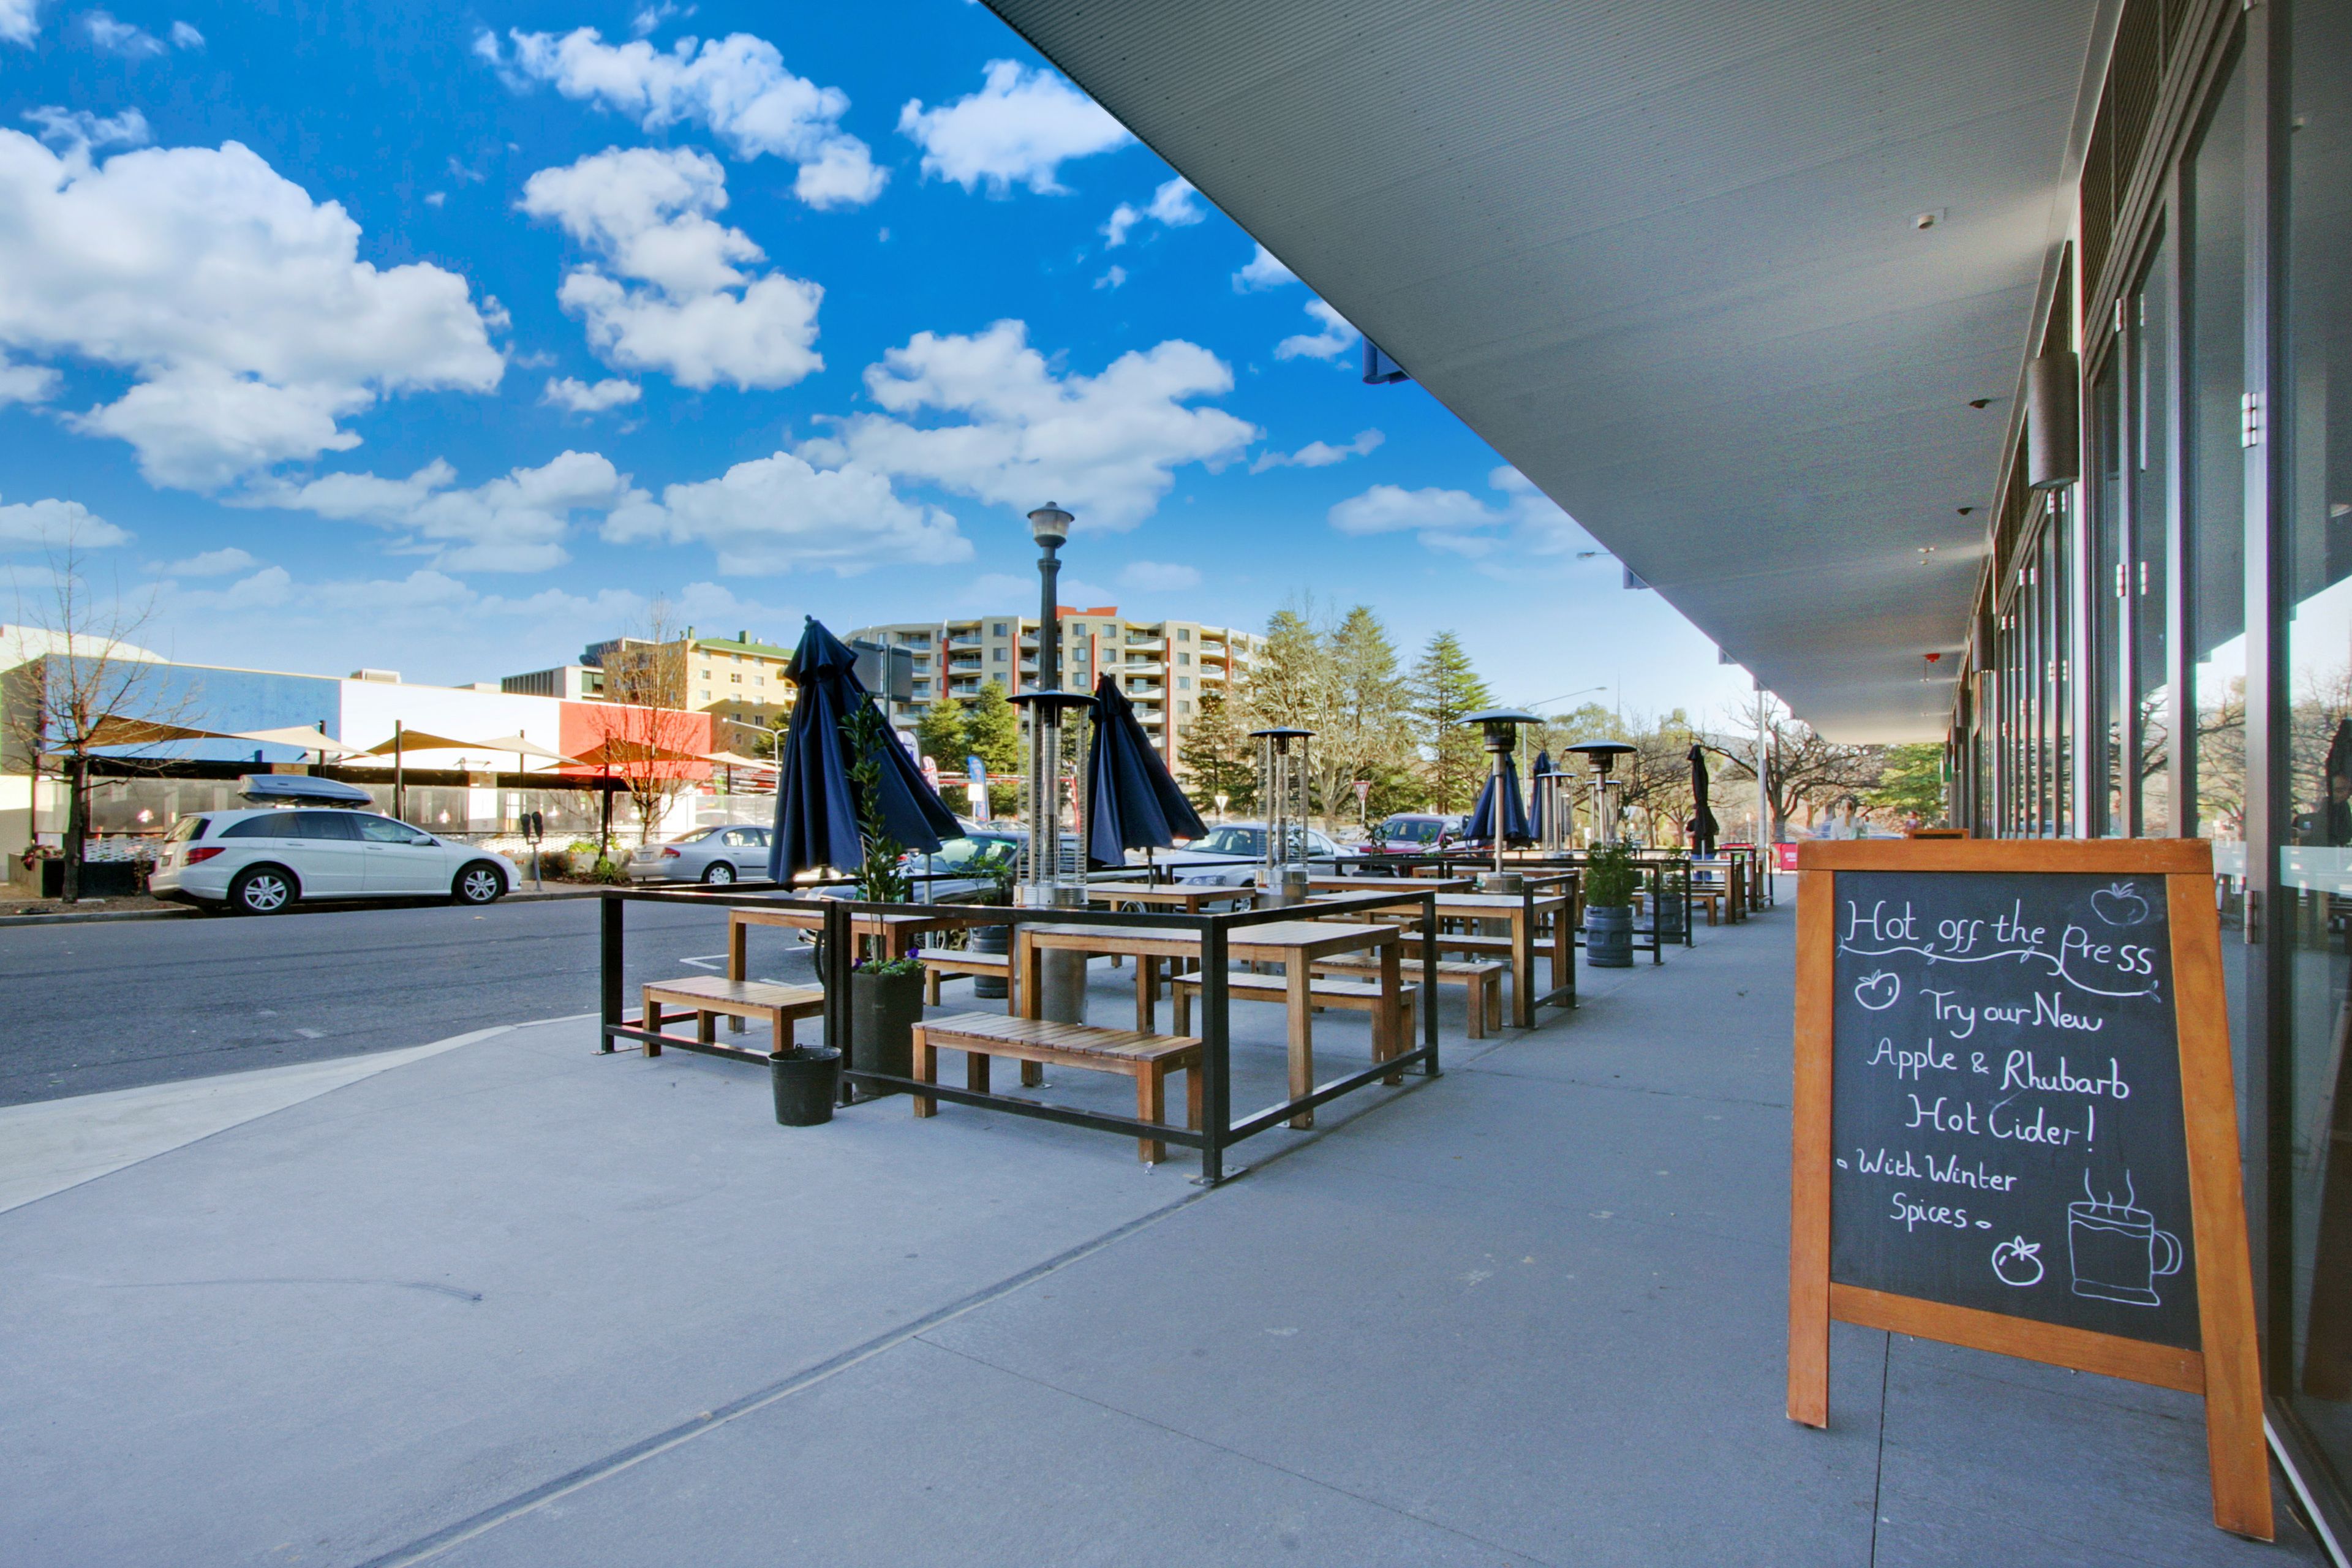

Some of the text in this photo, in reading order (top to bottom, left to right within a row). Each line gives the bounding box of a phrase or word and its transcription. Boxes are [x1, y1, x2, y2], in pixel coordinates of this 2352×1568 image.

[1845, 899, 2155, 975] Hot off the Press
[1920, 989, 2103, 1038] Try our New
[1866, 1038, 2130, 1099] Apple & Rhubarb
[1905, 1094, 1980, 1134] Hot
[1856, 1148, 2018, 1192] With Winter
[1890, 1192, 1967, 1232] Spices
